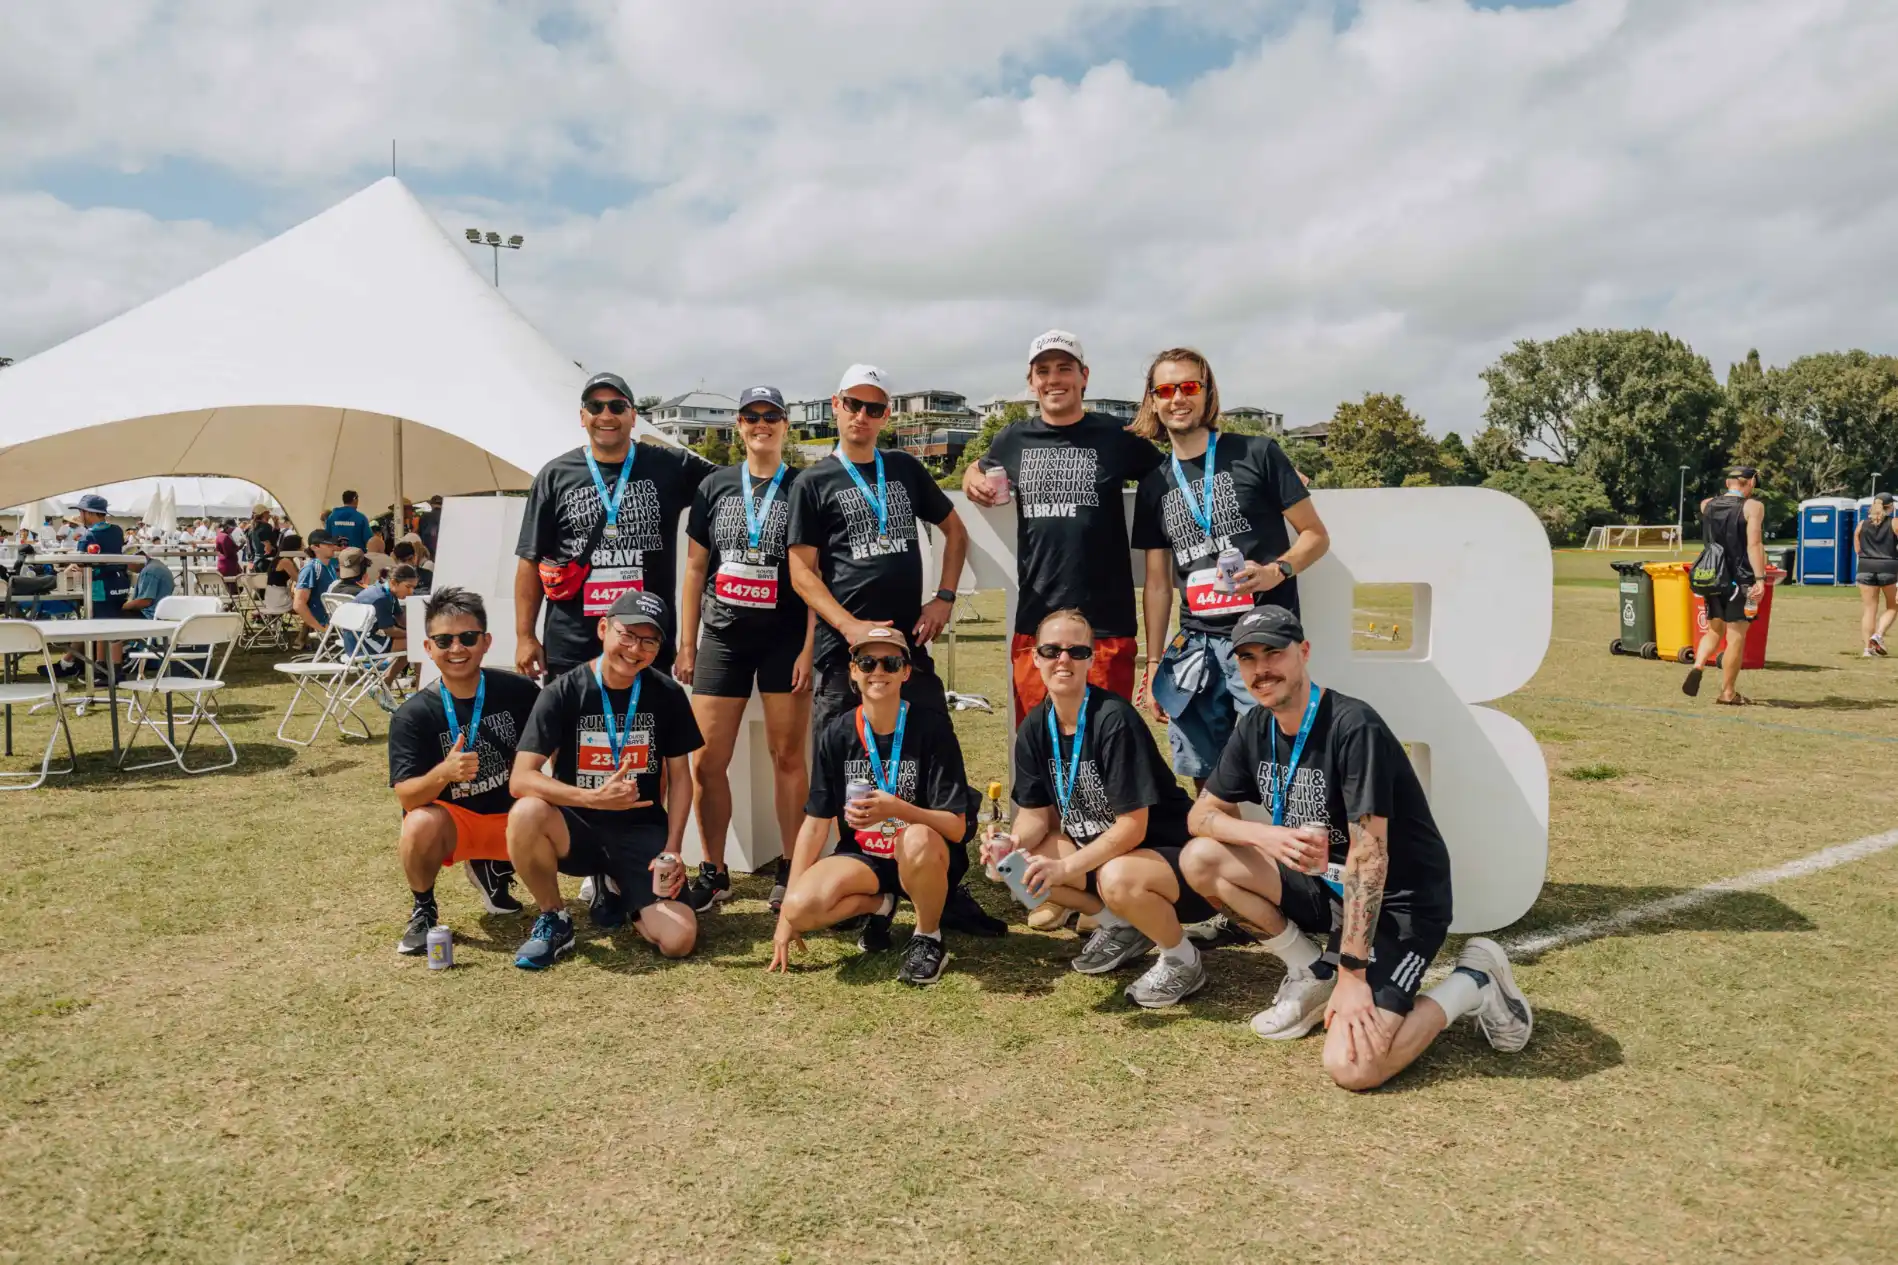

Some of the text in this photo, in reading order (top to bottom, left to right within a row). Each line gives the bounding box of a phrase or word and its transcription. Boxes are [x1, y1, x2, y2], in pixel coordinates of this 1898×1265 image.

[1022, 447, 1097, 461] RUN&RUN&
[1020, 459, 1097, 471] RUN&RUN&
[1019, 469, 1097, 482] RUN&RUN&
[1033, 504, 1077, 517] BRAVE
[591, 550, 643, 566] BRAVE
[852, 543, 869, 560] BE
[1175, 549, 1190, 566] BE
[722, 582, 771, 599] 44769
[590, 752, 638, 766] 2341
[470, 770, 509, 796] BRAVE
[577, 775, 592, 788] BE
[865, 838, 897, 850] 447
